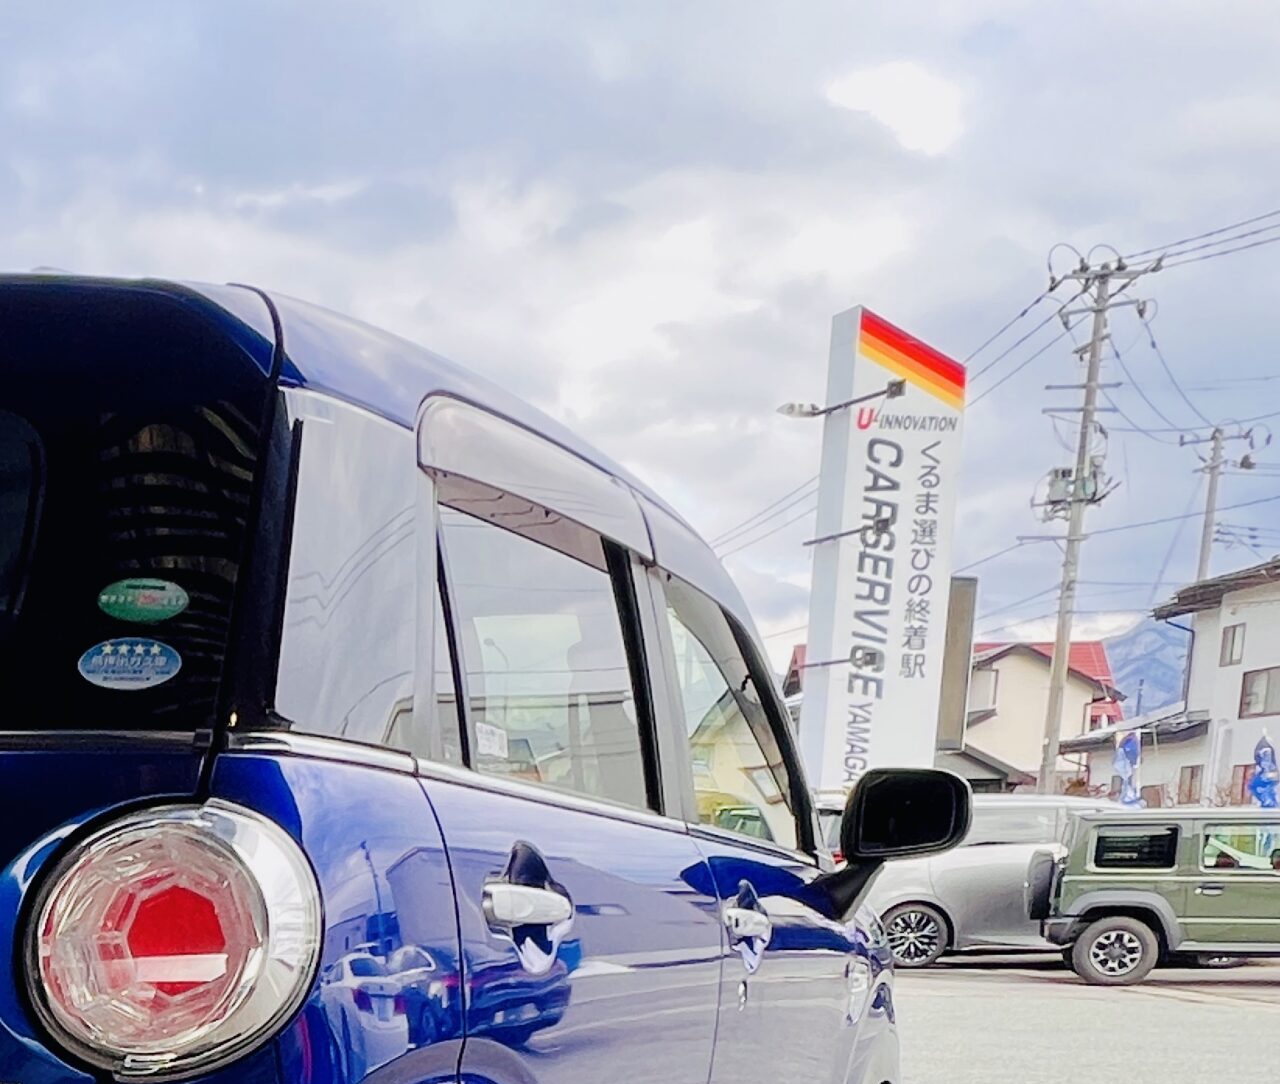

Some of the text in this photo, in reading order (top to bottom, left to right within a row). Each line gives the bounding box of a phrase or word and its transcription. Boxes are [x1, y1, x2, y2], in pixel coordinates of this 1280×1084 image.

[899, 440, 942, 679] くるま選びの終着駅
